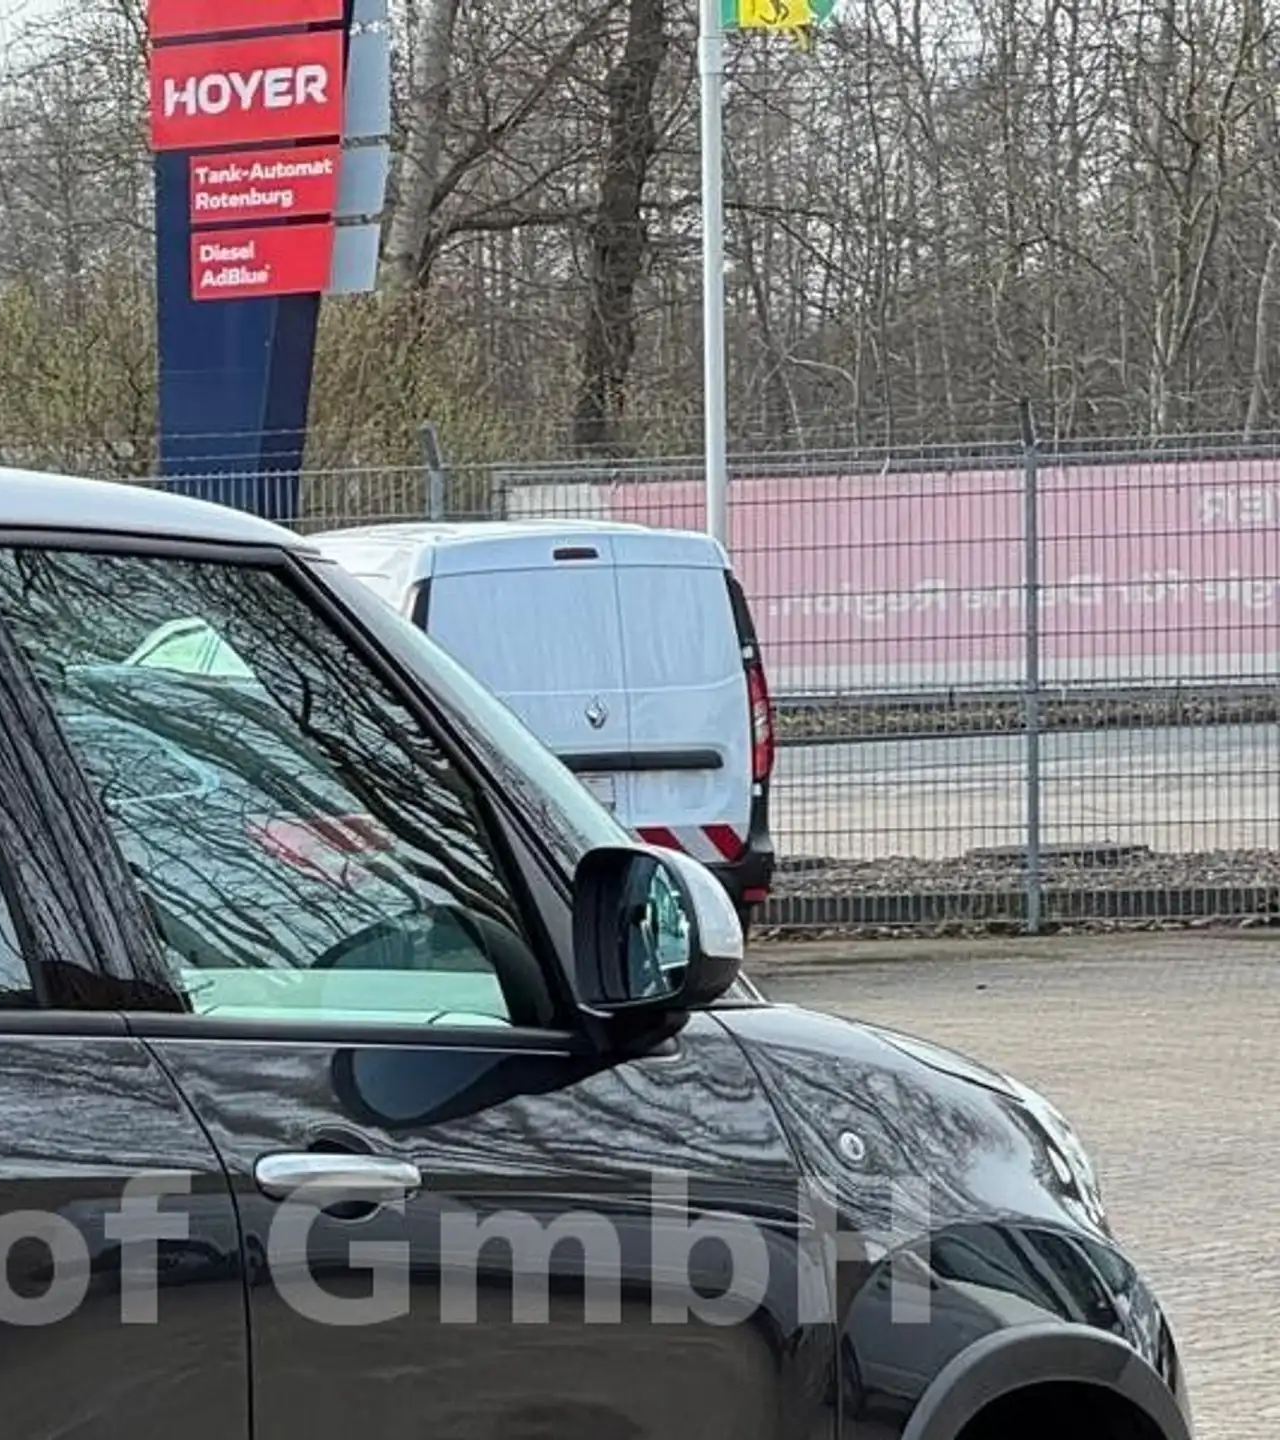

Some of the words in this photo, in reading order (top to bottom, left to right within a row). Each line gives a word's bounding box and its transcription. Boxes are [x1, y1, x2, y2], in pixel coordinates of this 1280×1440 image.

[163, 64, 328, 118] HOYER
[195, 159, 333, 184] Tank-Automat
[195, 187, 294, 209] Rotenburg
[200, 240, 255, 263] Diesel
